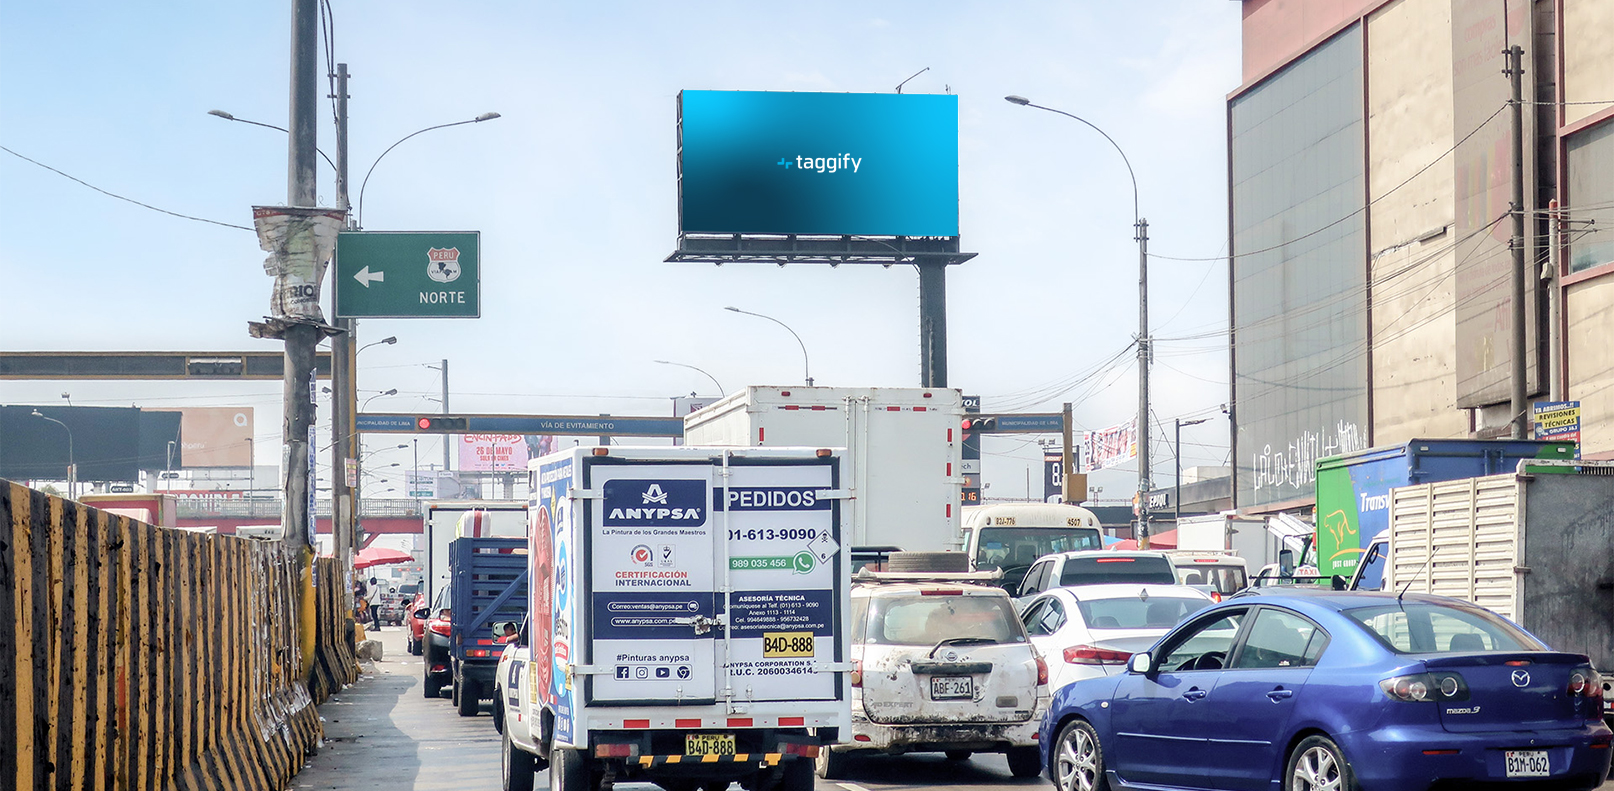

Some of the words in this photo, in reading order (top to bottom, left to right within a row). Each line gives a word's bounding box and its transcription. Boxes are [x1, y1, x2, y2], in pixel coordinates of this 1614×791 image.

[796, 153, 862, 173] taggify
[418, 291, 466, 304] NORTE
[1539, 410, 1576, 420] REVISIONES
[566, 422, 614, 430] EVITAMIENTO
[1545, 418, 1575, 428] TÉCNICAS
[495, 446, 512, 455] MAYO
[729, 490, 815, 507] PEDIDOS
[609, 508, 700, 520] ANYPSA
[821, 552, 826, 560] 6
[732, 559, 749, 568] 989
[750, 559, 768, 567] 035
[769, 559, 787, 567] 456
[615, 570, 688, 579] CERTIFICACIÓN
[1299, 568, 1317, 576] TAXI
[615, 579, 692, 587] INTERNACIONAL
[738, 594, 774, 602] ASESORÍA
[774, 594, 806, 602] TÉCNICA
[764, 637, 813, 653] B4D-888
[616, 653, 657, 662] #Pinturas
[659, 654, 690, 663] anypsa
[754, 660, 805, 668] CORPORATION
[757, 667, 818, 676] 2060034614
[688, 740, 733, 755] B4D-888
[1508, 757, 1548, 772] B1M-062
